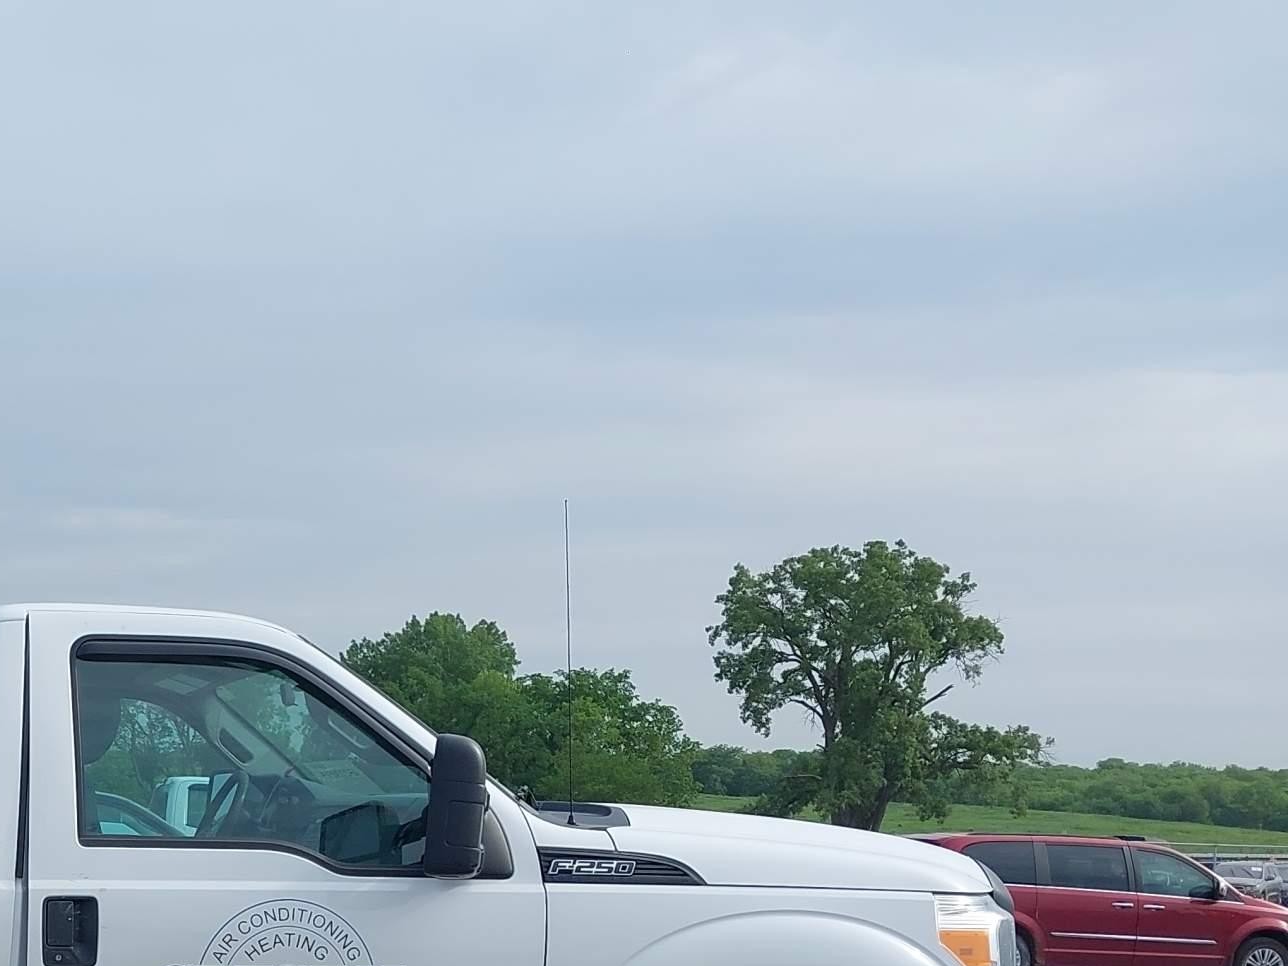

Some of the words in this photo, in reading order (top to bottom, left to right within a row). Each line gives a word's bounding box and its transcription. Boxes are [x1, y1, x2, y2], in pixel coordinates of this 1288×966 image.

[548, 859, 637, 877] F-250
[212, 933, 239, 964] AIR
[238, 907, 361, 963] CONDITIONING
[244, 932, 329, 962] HEATING
